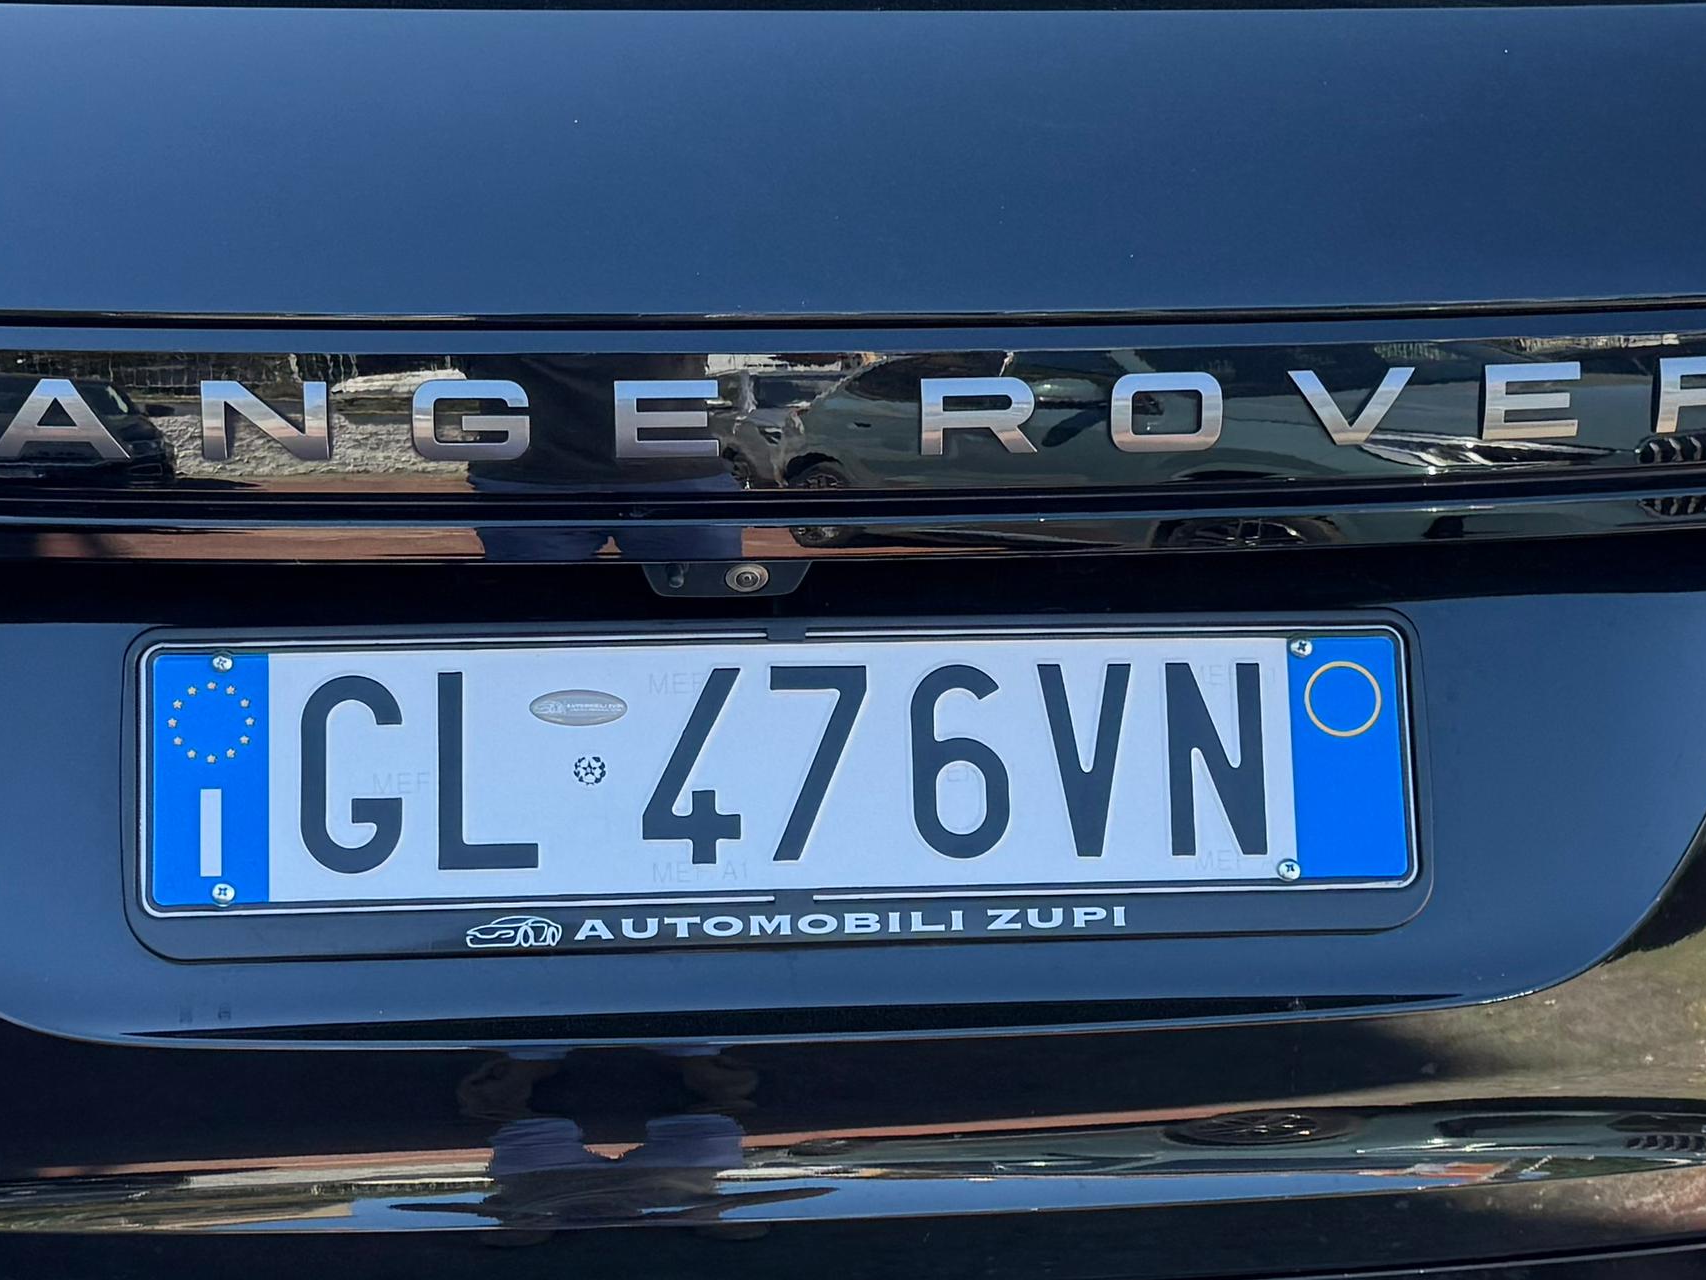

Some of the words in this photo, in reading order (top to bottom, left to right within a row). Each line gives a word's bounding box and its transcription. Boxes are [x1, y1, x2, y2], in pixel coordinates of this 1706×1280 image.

[301, 671, 539, 874] GL
[642, 662, 1269, 865] 476VN
[573, 910, 963, 941] AUTOMOBILI
[986, 905, 1126, 931] ZUPI
